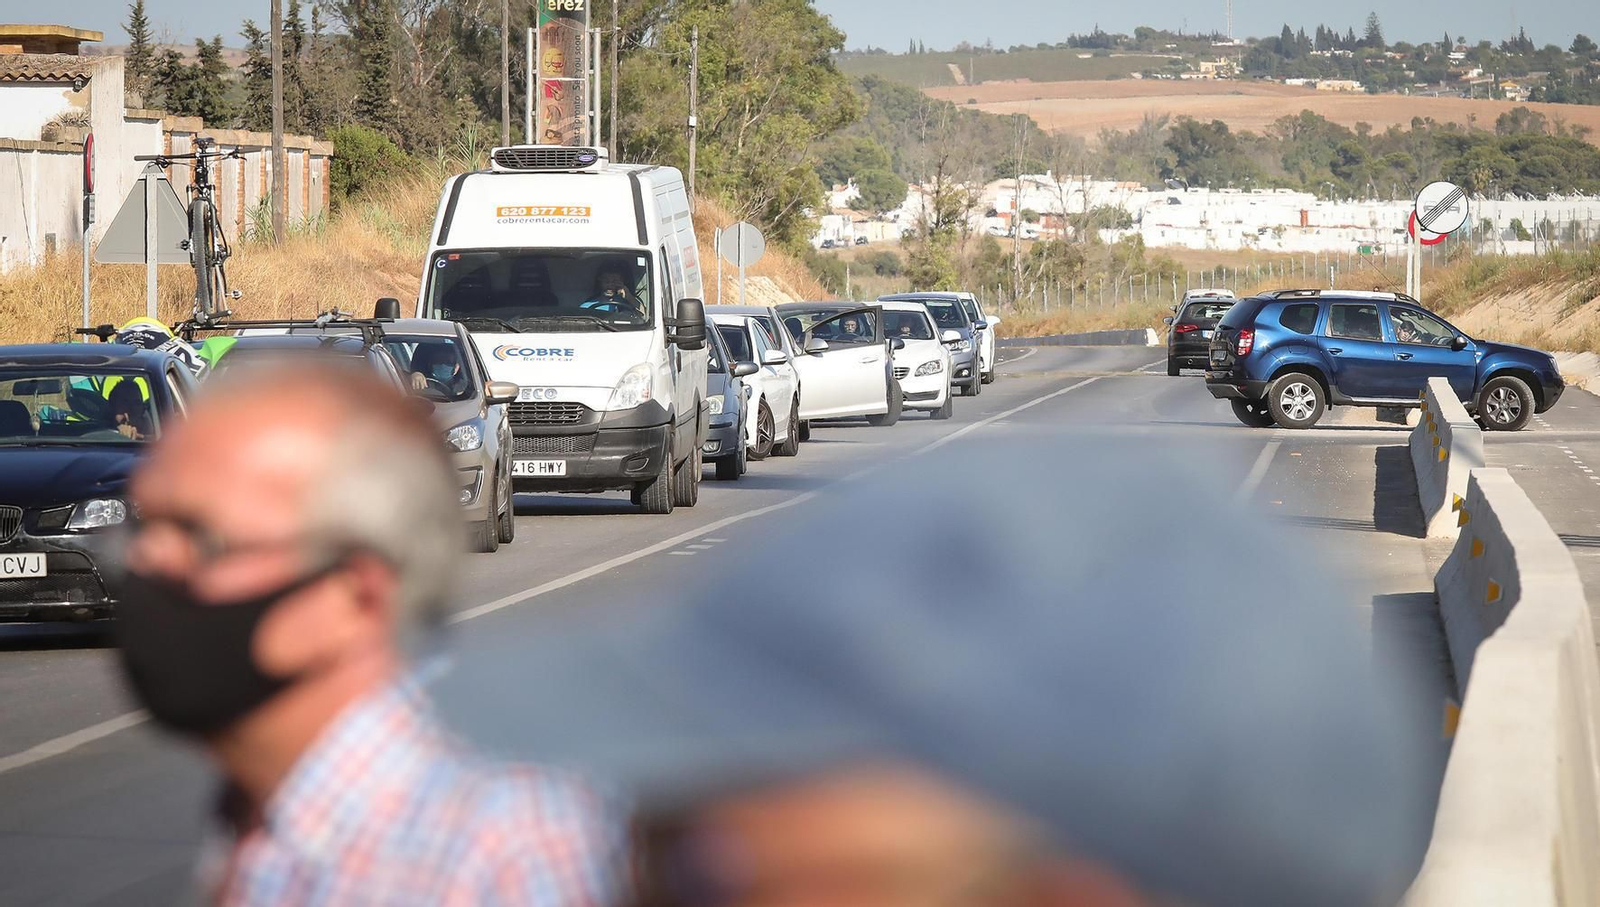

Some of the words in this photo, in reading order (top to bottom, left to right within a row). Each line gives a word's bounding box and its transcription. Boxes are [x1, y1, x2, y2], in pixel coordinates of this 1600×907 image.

[574, 58, 583, 73] you
[572, 75, 581, 91] See
[574, 96, 583, 124] pronto
[501, 207, 527, 216] 620
[531, 207, 557, 216] 877
[561, 207, 587, 216] 123
[437, 260, 447, 268] C
[505, 348, 575, 356] COBRE
[539, 462, 562, 473] HWY
[3, 556, 40, 574] CVJ
